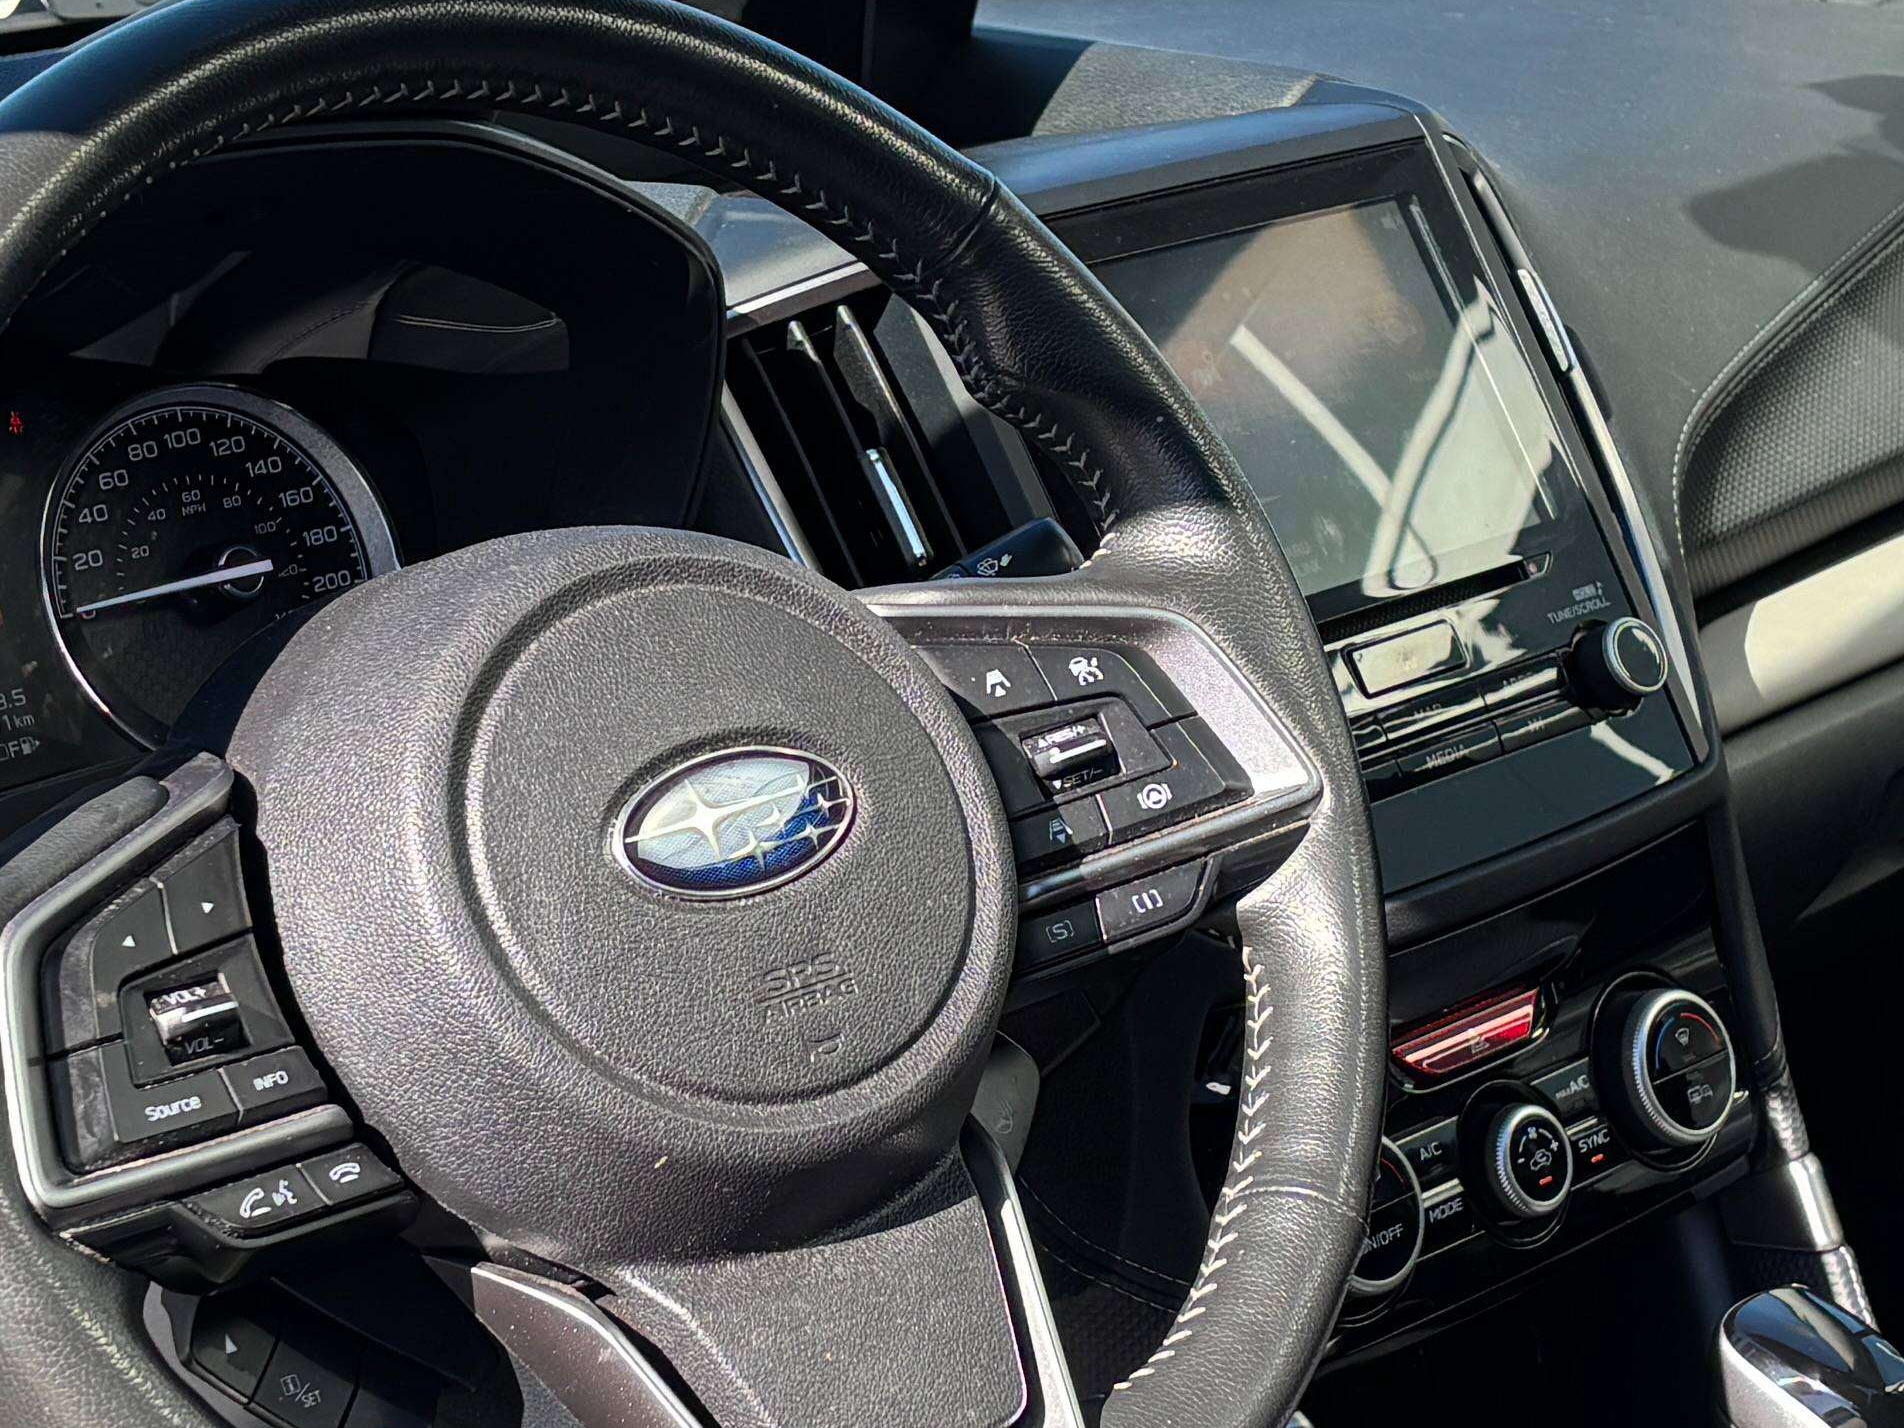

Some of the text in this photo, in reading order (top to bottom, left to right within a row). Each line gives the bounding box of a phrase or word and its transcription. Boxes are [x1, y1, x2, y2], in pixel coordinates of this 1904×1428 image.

[163, 427, 202, 450] 100
[209, 435, 246, 458] 120
[127, 440, 159, 462] 80
[245, 456, 283, 478] 140
[98, 469, 129, 491] 60
[181, 489, 201, 504] 60
[278, 486, 314, 509] 160
[78, 504, 109, 524] 40
[147, 508, 166, 522] 40
[181, 502, 207, 517] MPH
[254, 521, 277, 535] 100
[302, 525, 338, 547] 180
[72, 550, 104, 571] 20
[131, 545, 150, 559] 20
[313, 570, 351, 593] 200
[1547, 595, 1611, 624] TUNE/SCROLL
[8, 741, 20, 758] F
[1426, 744, 1467, 769] MEDIA
[763, 952, 837, 991] SRS
[763, 977, 858, 1022] AIRBAG
[253, 1070, 289, 1091] INFO
[1419, 1142, 1443, 1162] A/C
[1578, 1129, 1611, 1154] SYNC
[1429, 1199, 1465, 1223] MODE
